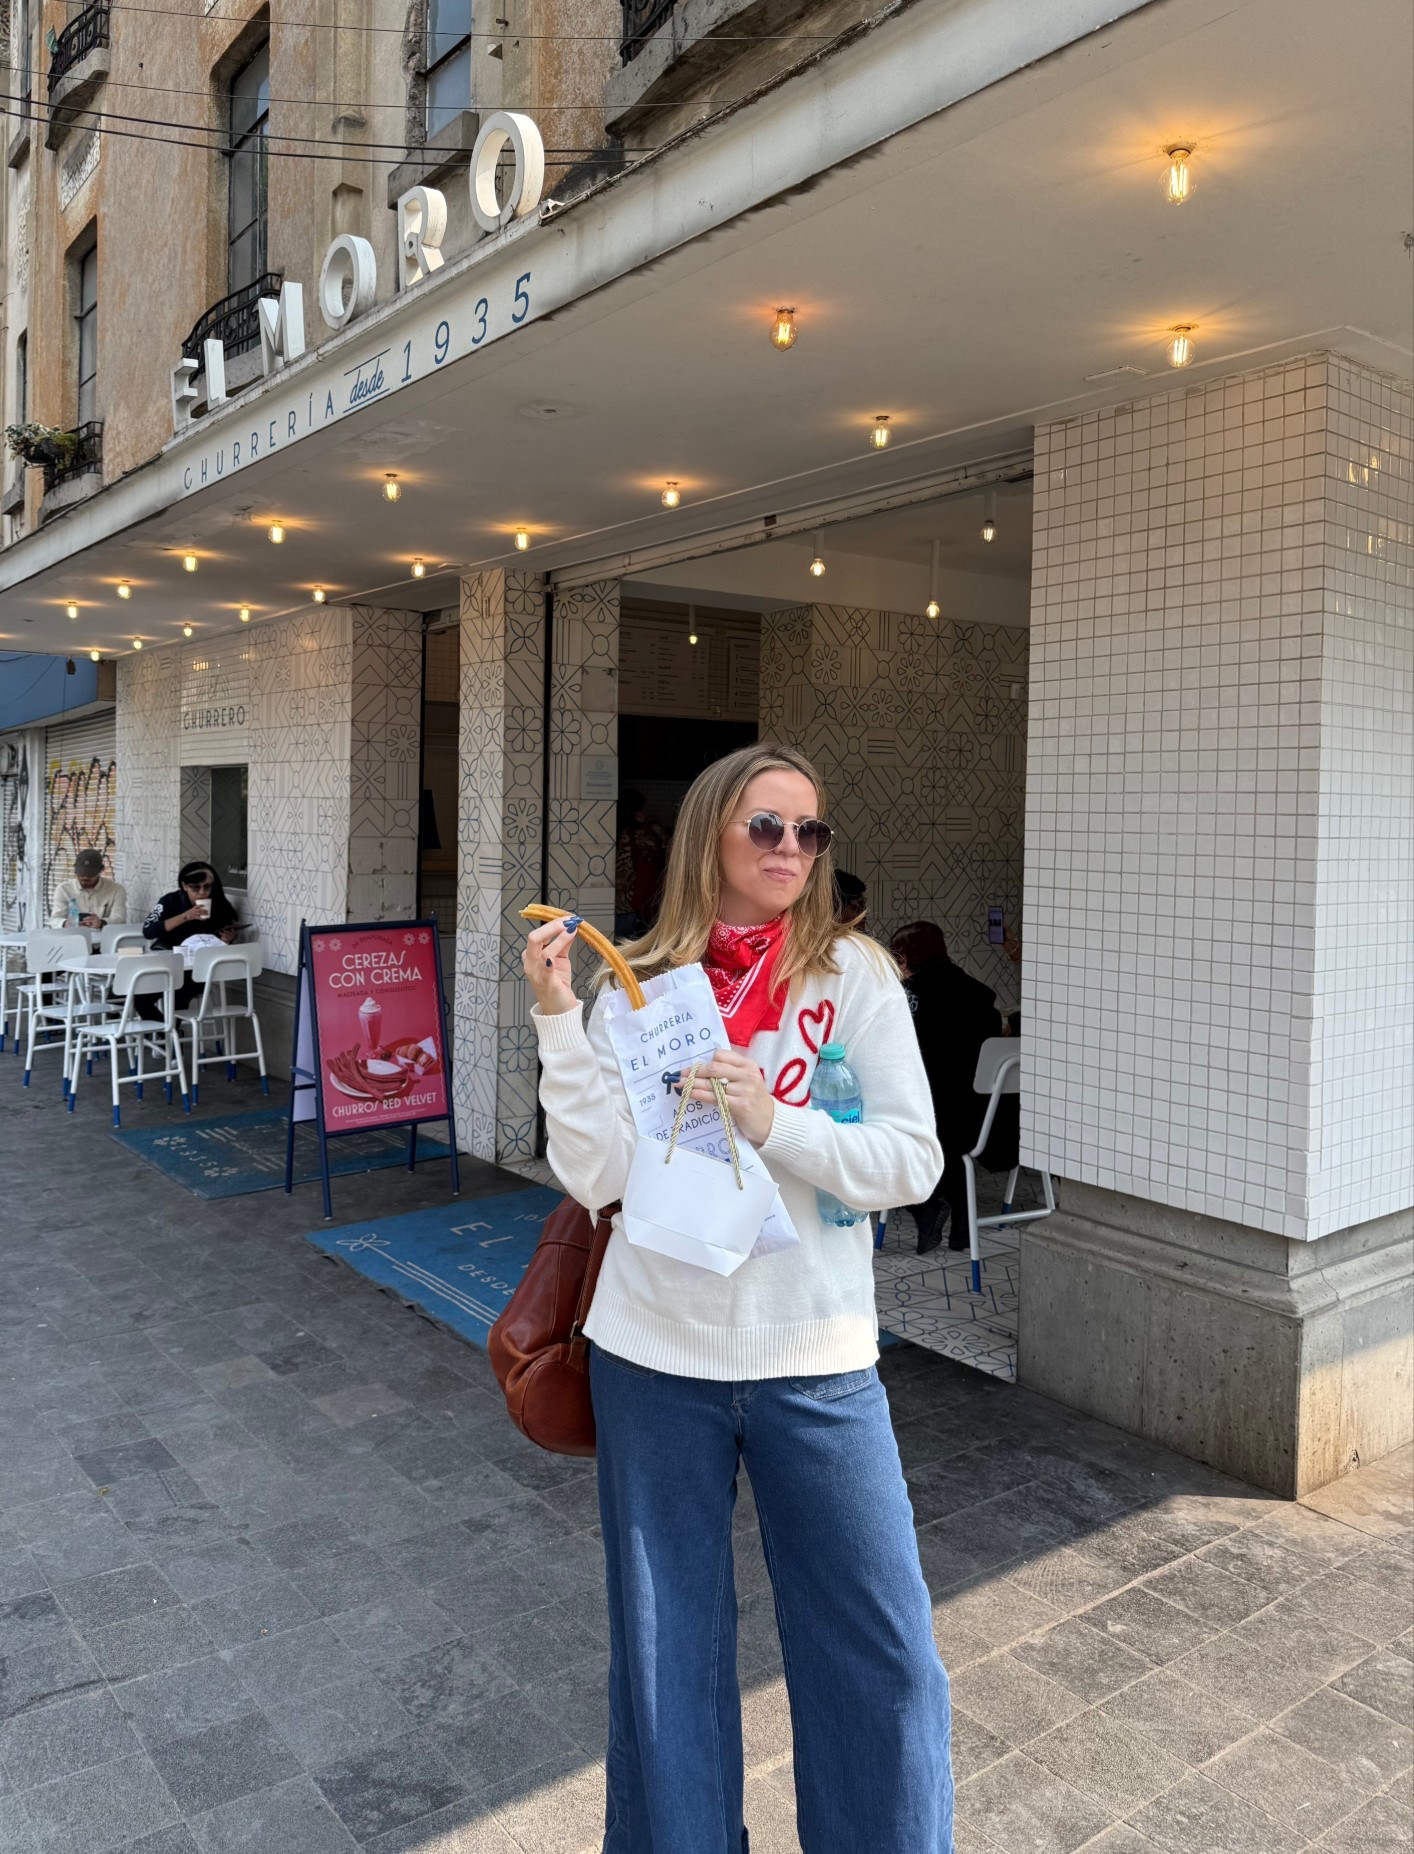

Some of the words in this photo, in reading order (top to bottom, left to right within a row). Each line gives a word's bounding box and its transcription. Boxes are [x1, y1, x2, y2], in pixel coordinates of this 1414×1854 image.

[171, 338, 232, 433] EL
[258, 111, 545, 376] MORO
[183, 391, 334, 491] CHURRERÍA
[349, 355, 386, 404] desde
[401, 271, 532, 383] 1935
[183, 705, 246, 730] CHURRERO
[342, 950, 406, 970] CEREZAS
[328, 971, 365, 988] CON
[370, 965, 423, 985] CREMA
[630, 1055, 649, 1071] EL
[657, 1027, 711, 1059] MORO
[332, 1100, 379, 1118] CHURROS
[382, 1097, 401, 1110] RED
[403, 1092, 437, 1107] VELVET
[639, 1092, 656, 1107] 1935
[673, 1100, 703, 1119] AOS
[656, 1129, 670, 1141] DE
[449, 1221, 515, 1249] EL
